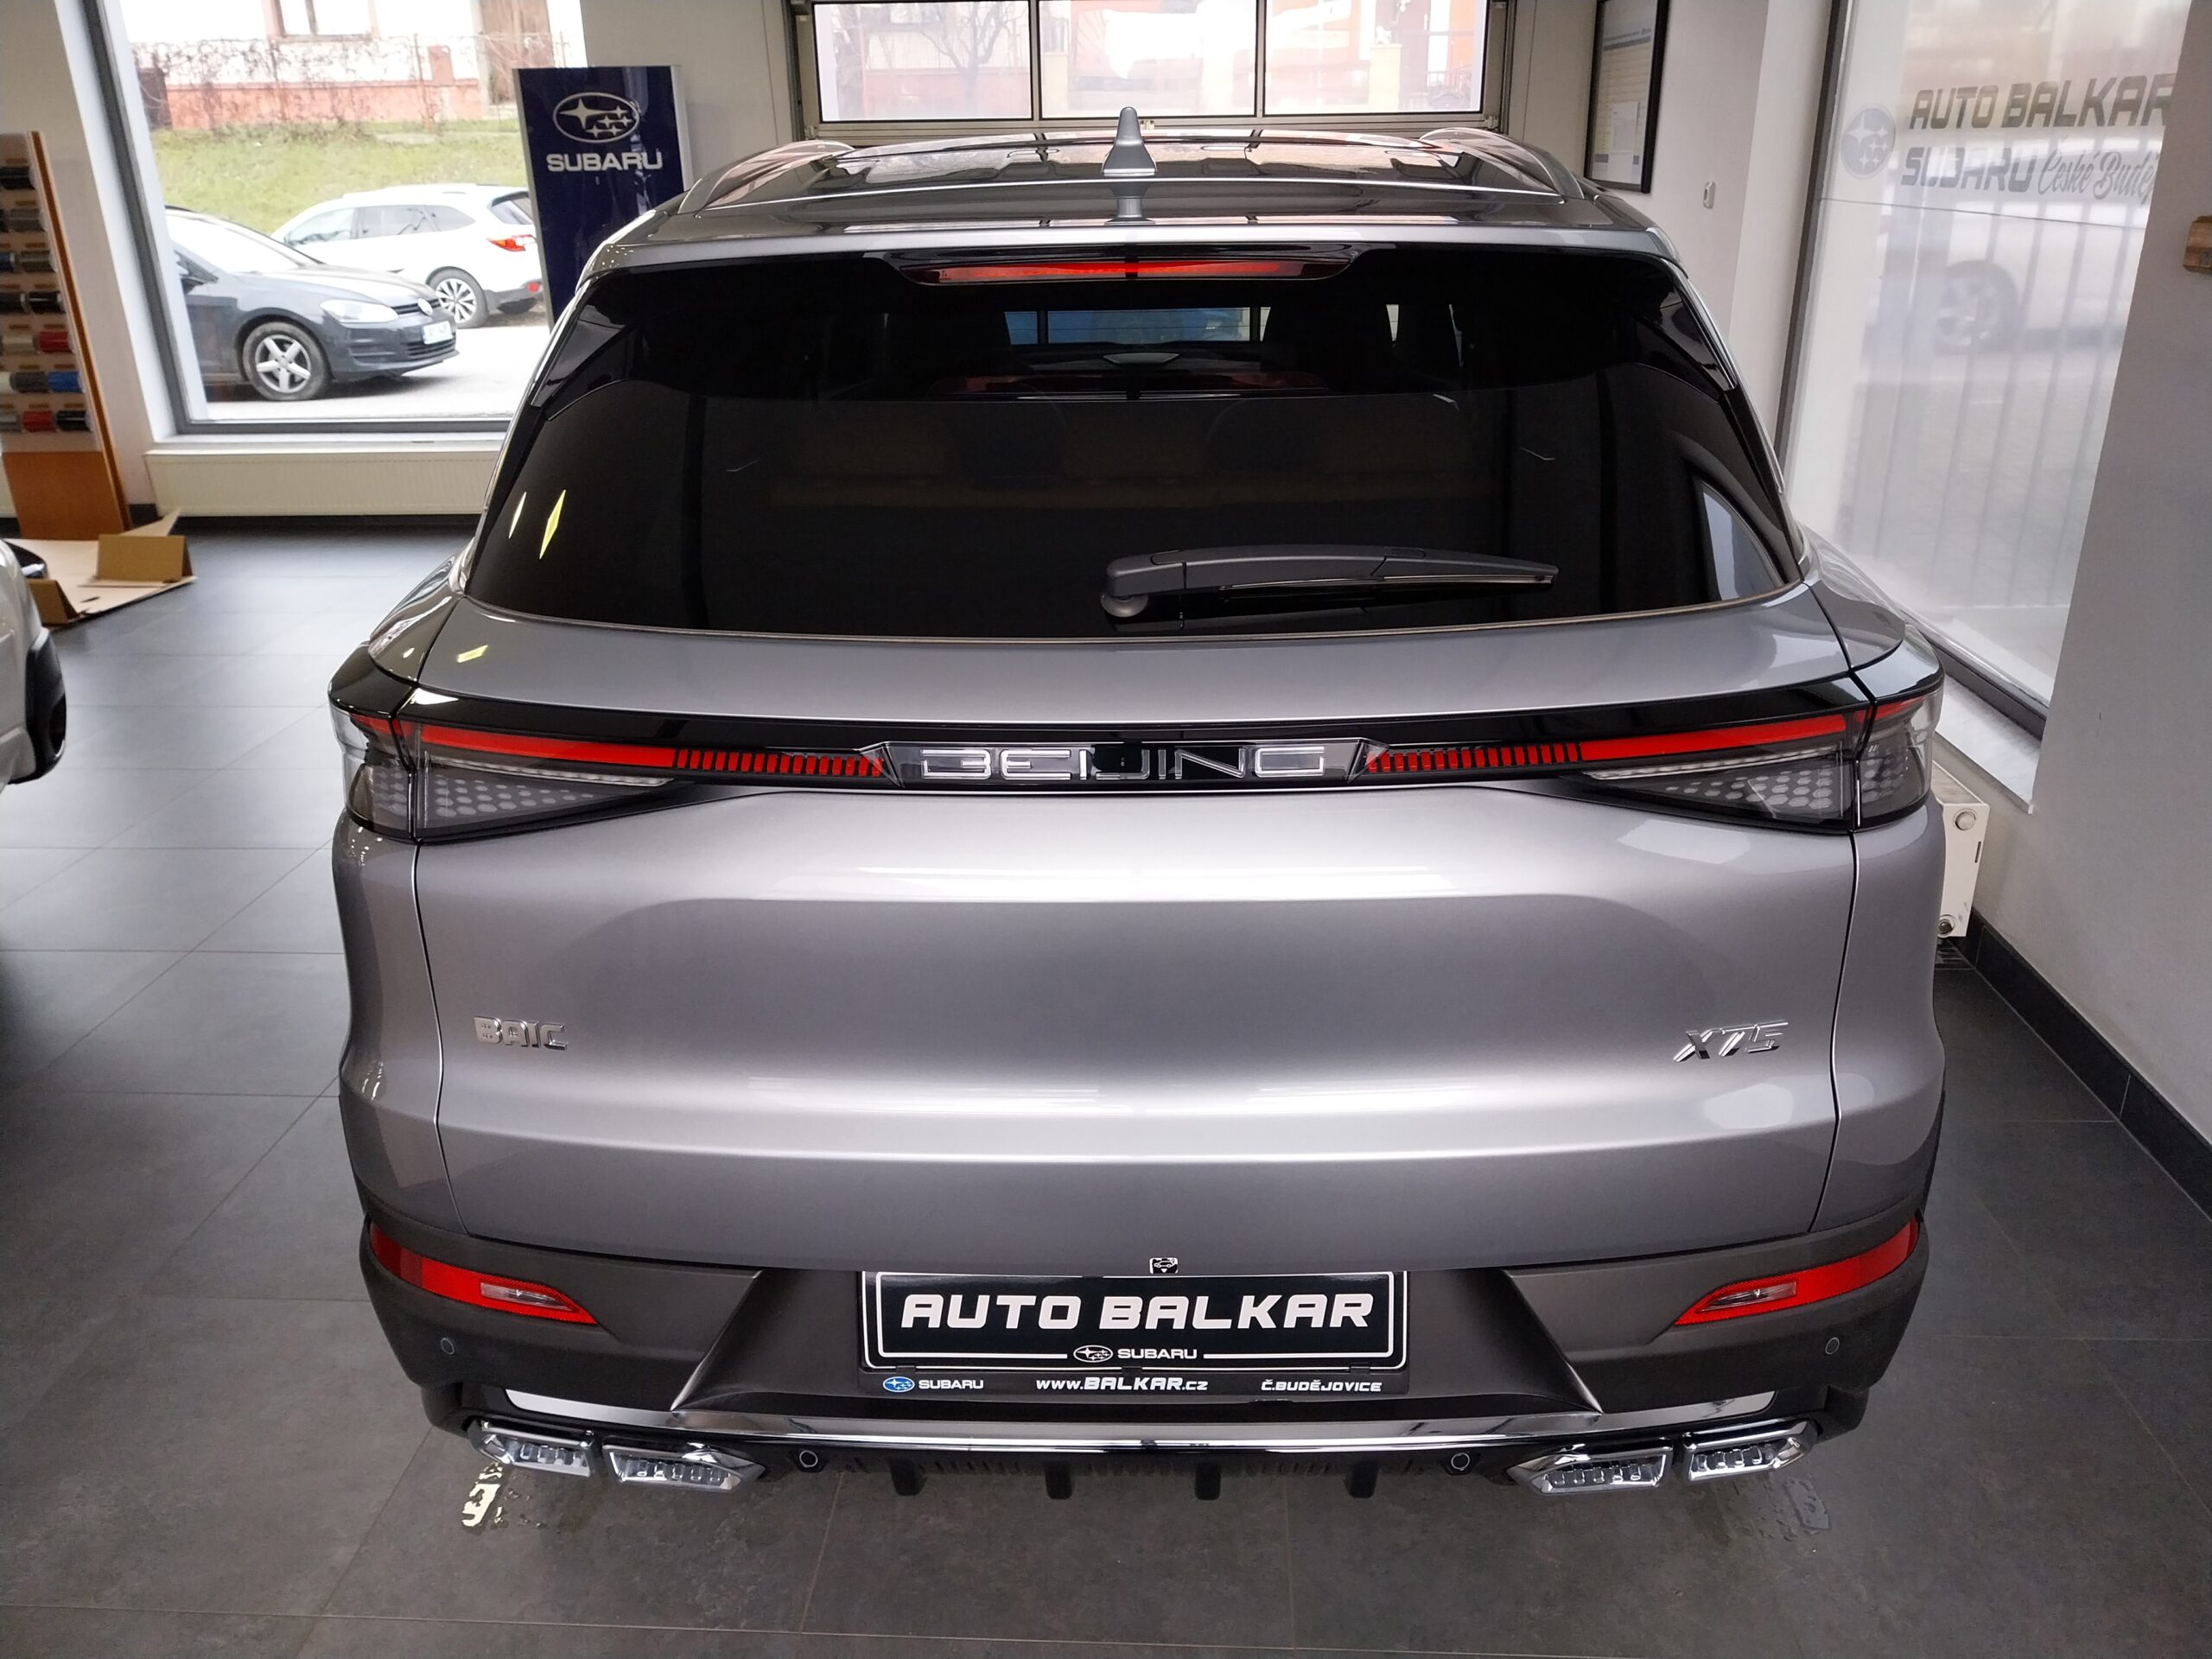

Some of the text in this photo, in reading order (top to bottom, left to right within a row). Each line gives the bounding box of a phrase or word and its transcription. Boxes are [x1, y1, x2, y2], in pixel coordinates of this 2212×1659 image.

[1909, 85, 1999, 130] AUTO
[546, 151, 664, 172] SUBARU
[1900, 146, 2038, 193] SUBARU
[920, 746, 1327, 781] BEIJING
[474, 1015, 569, 1052] BAIC
[1672, 1020, 1789, 1063] X75
[900, 1293, 1374, 1330] AUTO BALKAR
[1117, 1348, 1198, 1360] SUBARU
[918, 1379, 985, 1390] SUBARU
[1035, 1376, 1210, 1391] www.BALKAR.cz
[1260, 1378, 1383, 1392] Č.BUDĚJOVICE
